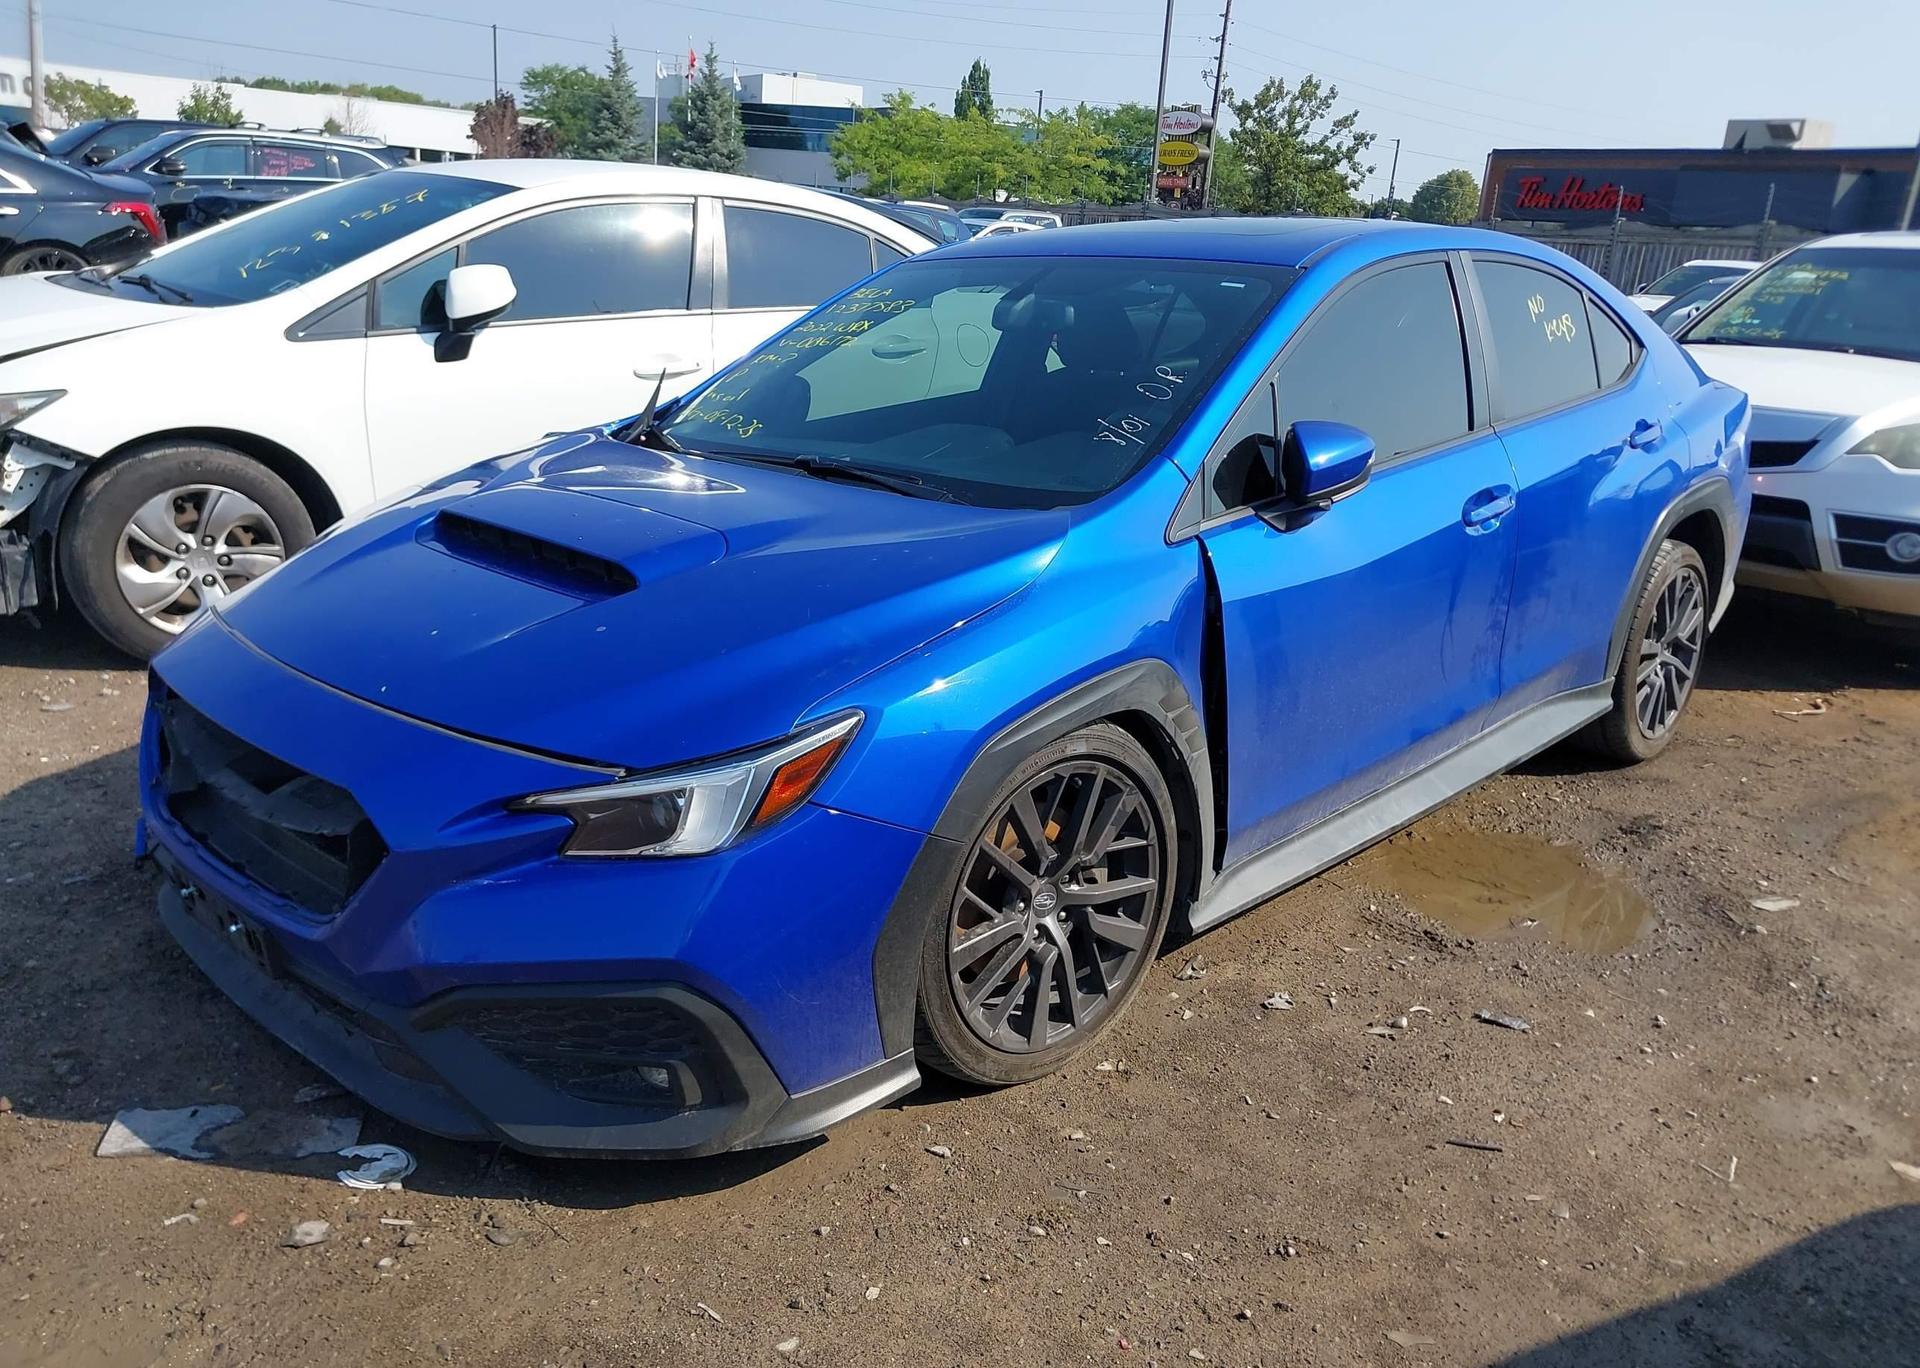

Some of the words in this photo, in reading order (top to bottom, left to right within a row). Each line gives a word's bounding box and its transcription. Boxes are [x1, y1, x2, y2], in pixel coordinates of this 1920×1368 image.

[1162, 115, 1174, 130] Tim
[1173, 115, 1200, 131] Hortons
[1159, 148, 1177, 158] LWAYS
[1516, 176, 1553, 209] Tim
[1554, 176, 1645, 213] Hortons
[1527, 293, 1545, 323] NO
[833, 319, 875, 333] WRX
